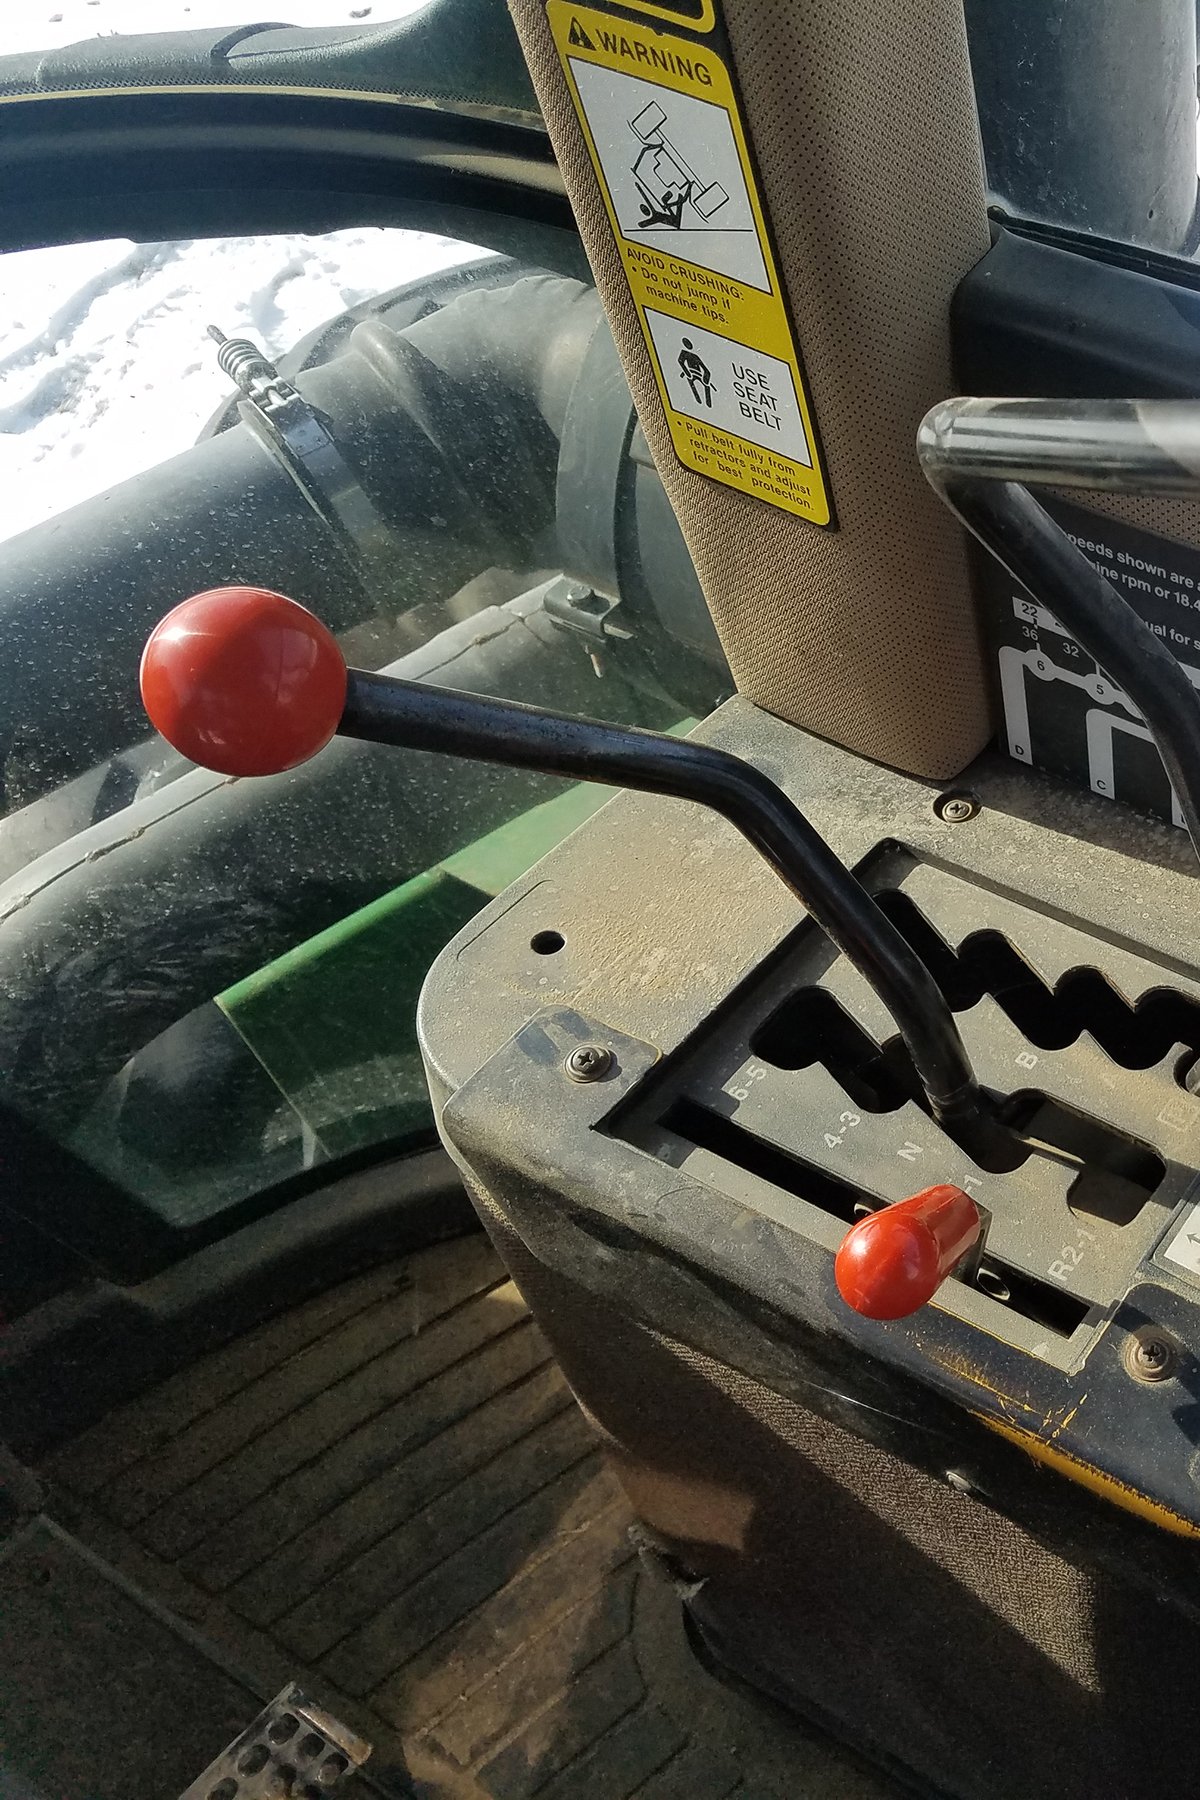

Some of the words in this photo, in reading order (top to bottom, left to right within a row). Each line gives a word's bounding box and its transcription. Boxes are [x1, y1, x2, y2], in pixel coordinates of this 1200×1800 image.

[596, 29, 713, 87] WARNING
[627, 247, 665, 270] AVOID
[669, 263, 745, 301] CRUSHING:
[641, 267, 658, 282] Do
[663, 277, 683, 291] not
[687, 284, 718, 306] jump
[721, 297, 731, 310] if
[645, 285, 698, 312] machine
[702, 304, 730, 324] tips.
[732, 362, 771, 391] USE
[733, 381, 778, 412] SEAT
[739, 401, 782, 432] BELT
[685, 421, 708, 439] Pull
[712, 432, 735, 450] belt
[738, 444, 764, 463] fully
[768, 456, 796, 477] from
[689, 437, 747, 468] retractors
[750, 463, 772, 478] and
[775, 473, 812, 497] adjust
[693, 450, 710, 465] for
[717, 460, 744, 480] best
[751, 476, 816, 511] protection.
[1066, 533, 1114, 560] peeds
[1116, 549, 1168, 579] shown
[1170, 570, 1195, 590] are
[1121, 572, 1152, 595] rpm
[1154, 585, 1171, 600] or
[1021, 603, 1038, 617] 22
[1021, 625, 1038, 641] 36
[1062, 642, 1079, 658] 32
[1169, 628, 1191, 646] for
[1036, 660, 1046, 671] 6
[1095, 684, 1105, 696] 5
[1014, 745, 1024, 756] D
[1096, 779, 1107, 790] C
[1015, 1052, 1038, 1070] B
[728, 1064, 767, 1101] 6-5
[823, 1110, 861, 1149] 4-3
[897, 1141, 924, 1162] N
[1047, 1228, 1095, 1281] R2-1
